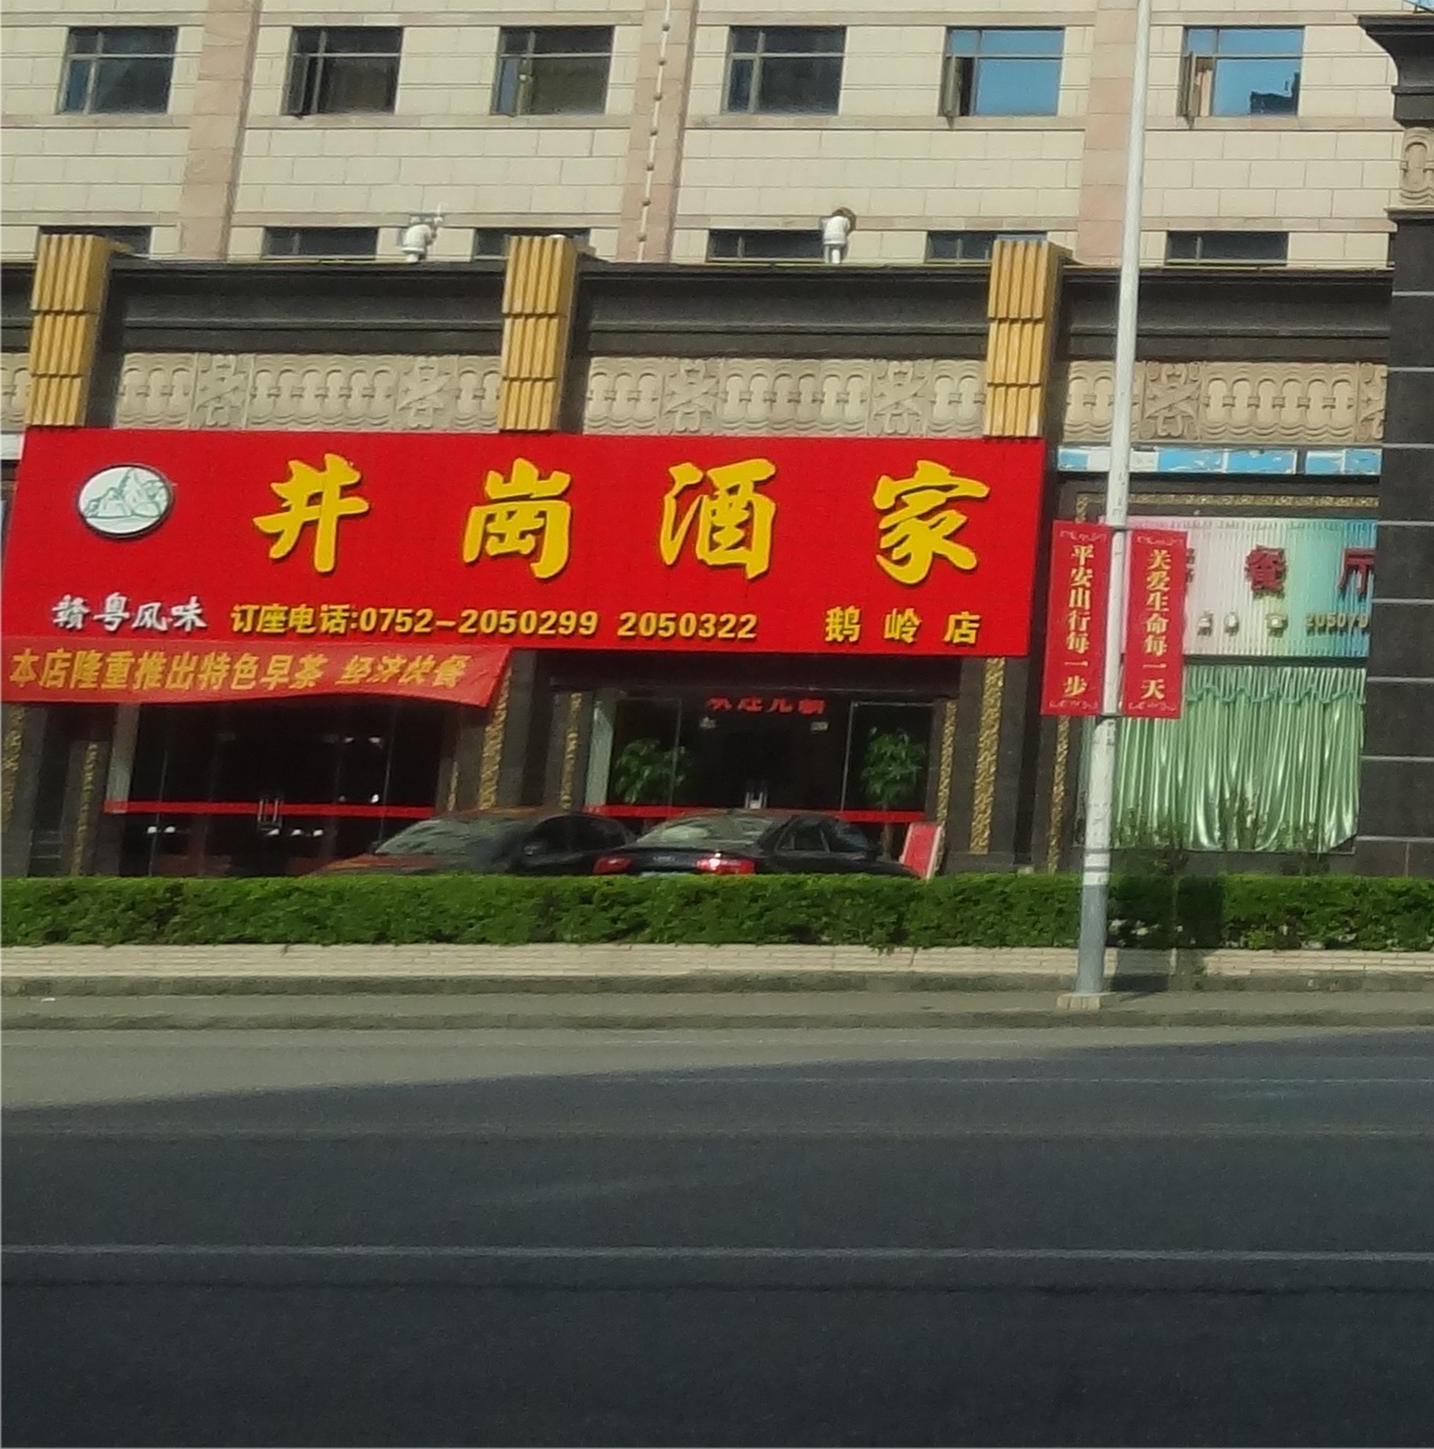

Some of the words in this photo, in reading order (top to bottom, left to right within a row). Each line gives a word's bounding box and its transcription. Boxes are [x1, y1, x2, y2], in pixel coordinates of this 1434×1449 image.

[253, 452, 990, 585] 井岗酒家
[52, 591, 208, 633] 赣粤风味
[617, 611, 758, 639] 2050322
[824, 606, 981, 644] 鹅岭店
[1064, 545, 1093, 696] 平安出行每一步
[1142, 549, 1171, 700] 关爱生命每一天
[9, 648, 328, 691] 本店隆重推出特色早茶
